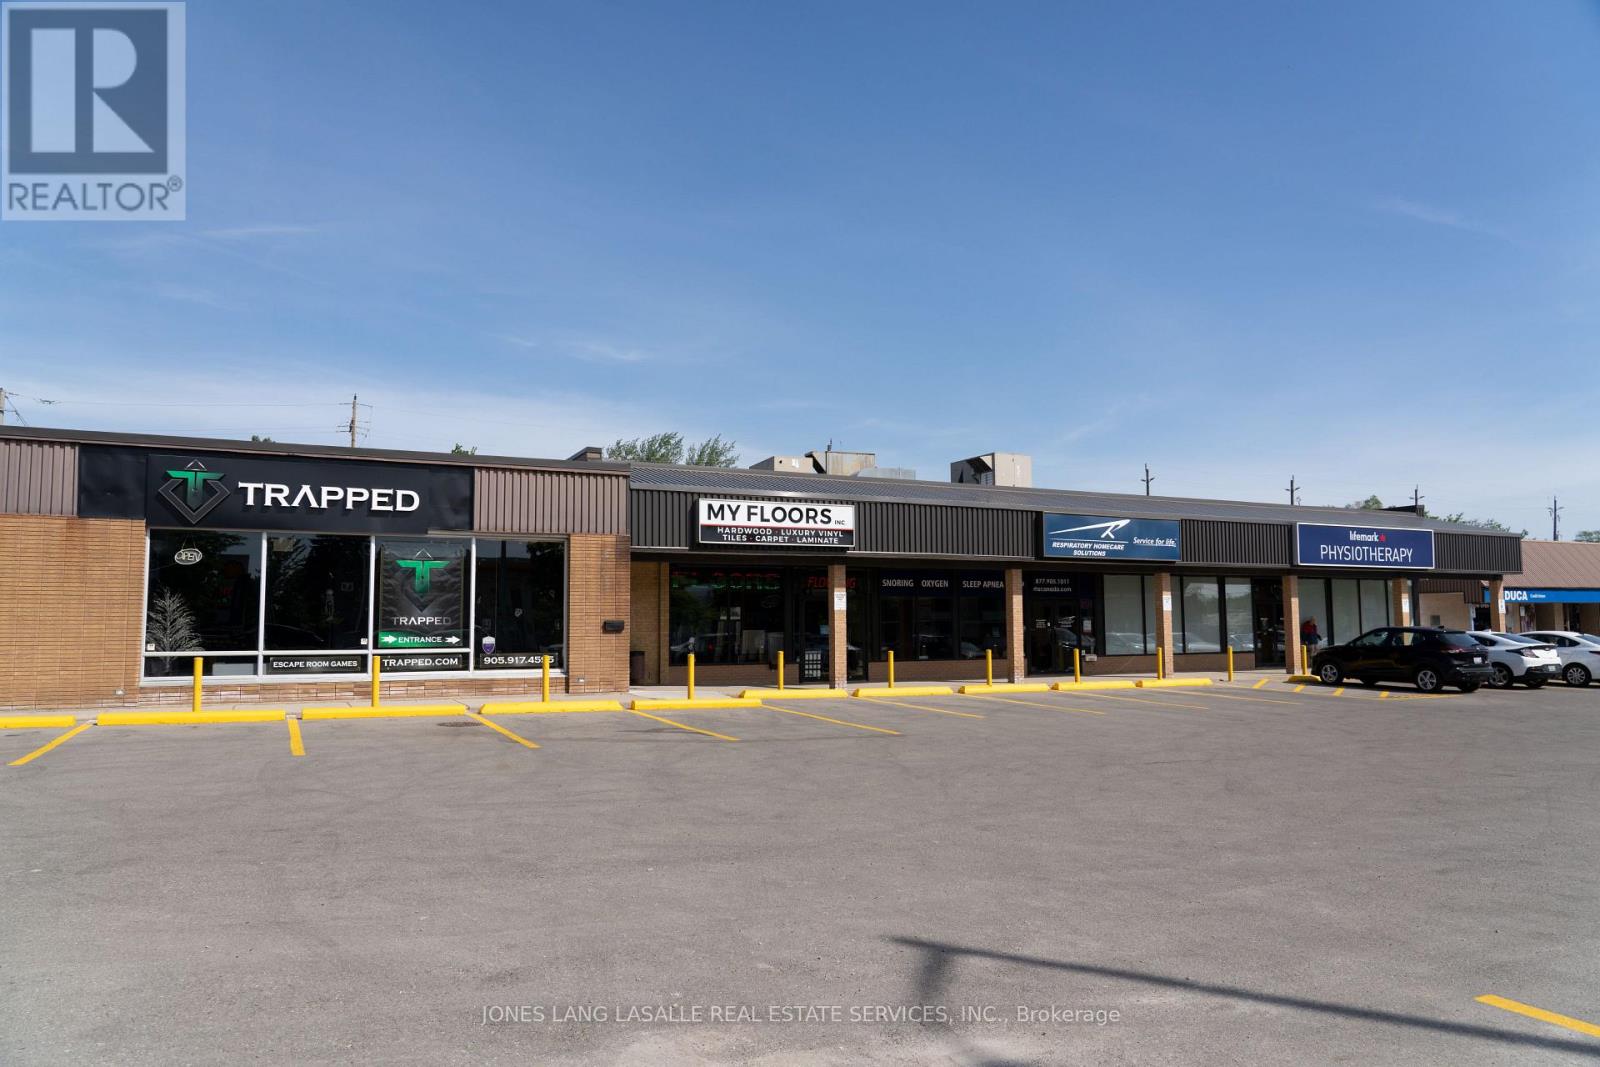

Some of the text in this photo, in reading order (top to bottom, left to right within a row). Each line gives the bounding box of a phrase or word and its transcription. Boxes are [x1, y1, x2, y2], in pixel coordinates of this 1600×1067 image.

[238, 481, 420, 512] TRAPPED
[707, 503, 741, 521] MY
[746, 505, 832, 525] FLOORS
[717, 527, 844, 538] HARDWOOD LUXURY VINYL
[1349, 530, 1379, 542] lifemark
[722, 534, 839, 544] TILES CARPET LAMINATE
[1132, 536, 1154, 545] Service
[1155, 537, 1165, 547] for
[1052, 541, 1125, 551] RESPIRATORY HOMECARE
[1073, 549, 1106, 557] SOLUTIONS
[1320, 544, 1413, 562] PHYSIOTHERAPY
[882, 579, 1004, 589] SNORING OXYGEN SLEEP APNEA
[1504, 590, 1528, 601] DUCA
[392, 616, 451, 626] TRAPPED
[398, 636, 443, 644] ENTRANCE
[382, 657, 459, 667] TRAPPED.COM
[483, 655, 555, 665] 905.917.455
